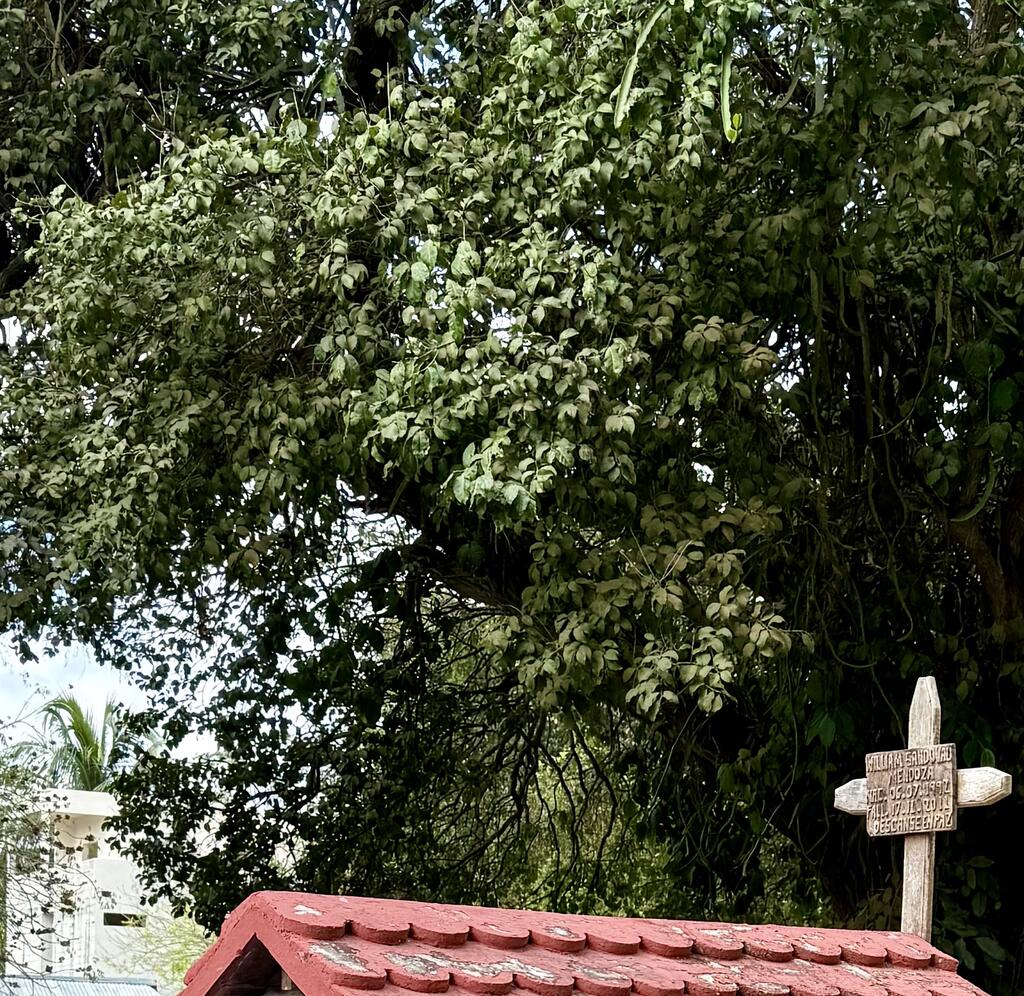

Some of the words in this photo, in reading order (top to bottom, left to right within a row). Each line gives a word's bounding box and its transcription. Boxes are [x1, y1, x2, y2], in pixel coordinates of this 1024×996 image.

[888, 766, 934, 786] MENDOZA
[873, 816, 921, 835] DESCANSE
[933, 812, 952, 829] PAZ
